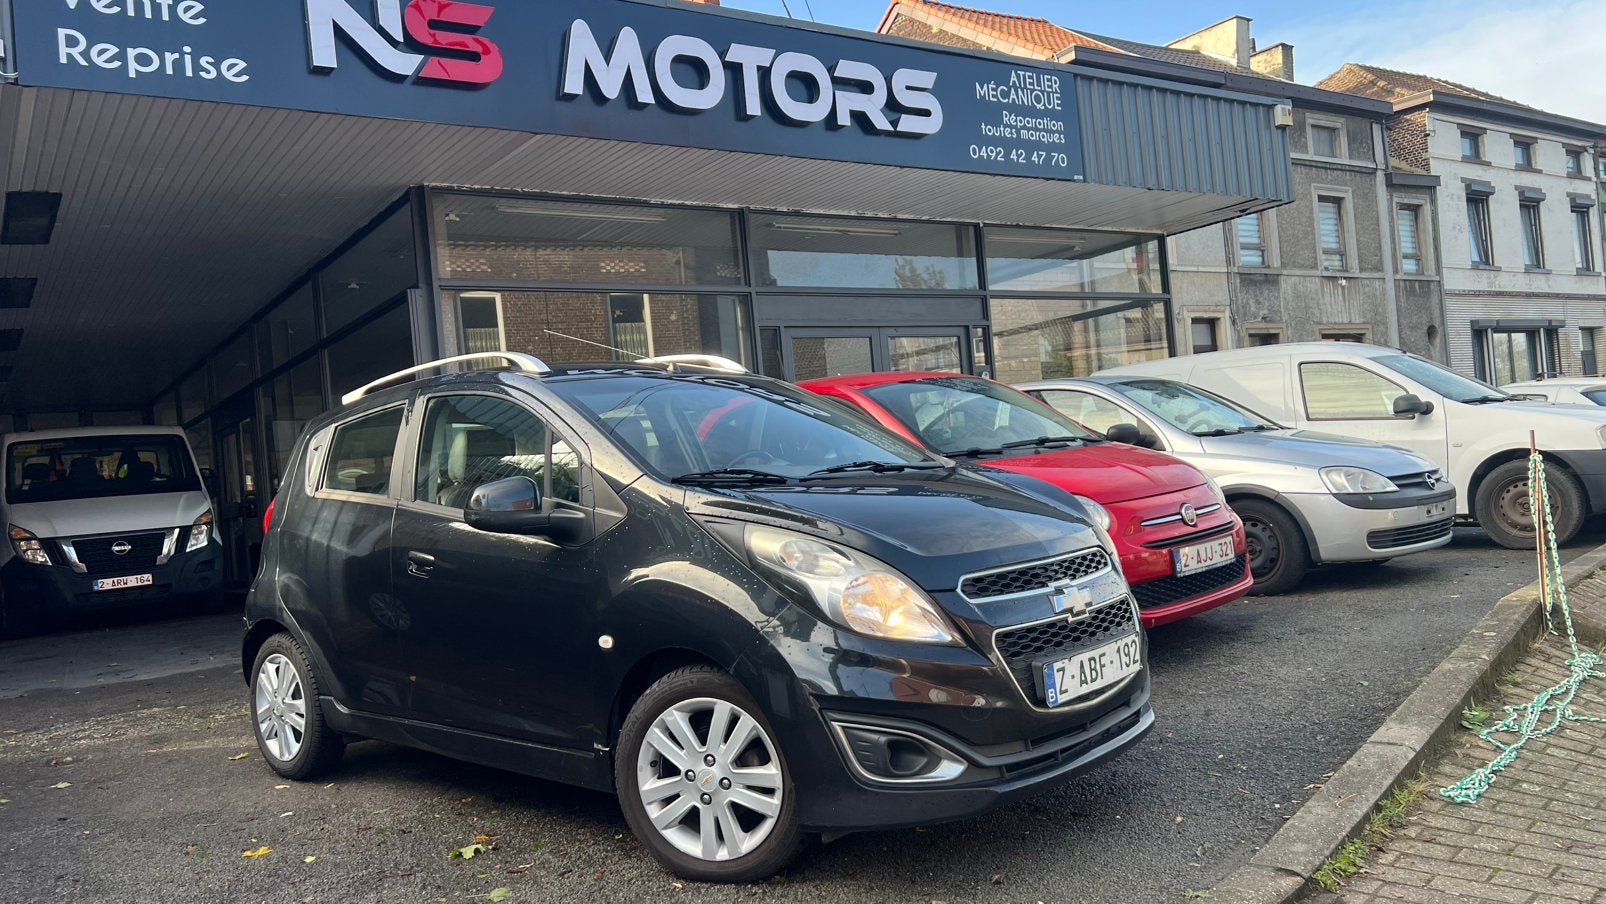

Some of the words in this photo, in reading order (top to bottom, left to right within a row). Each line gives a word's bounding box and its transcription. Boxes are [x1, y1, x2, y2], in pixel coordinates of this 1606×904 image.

[65, 0, 207, 25] ente
[57, 28, 250, 83] Reprise
[306, 0, 503, 84] NS
[562, 18, 943, 135] MOTORS
[1009, 69, 1060, 93] ATELIER
[975, 81, 1062, 110] MÉCANIQUE
[1002, 110, 1064, 131] Réparation
[981, 122, 1017, 138] toutes
[1020, 129, 1065, 144] marques
[969, 144, 1005, 161] 0492
[1010, 148, 1027, 163] 42
[1031, 150, 1046, 165] 47
[1050, 152, 1068, 167] 70
[1048, 688, 1056, 702] B
